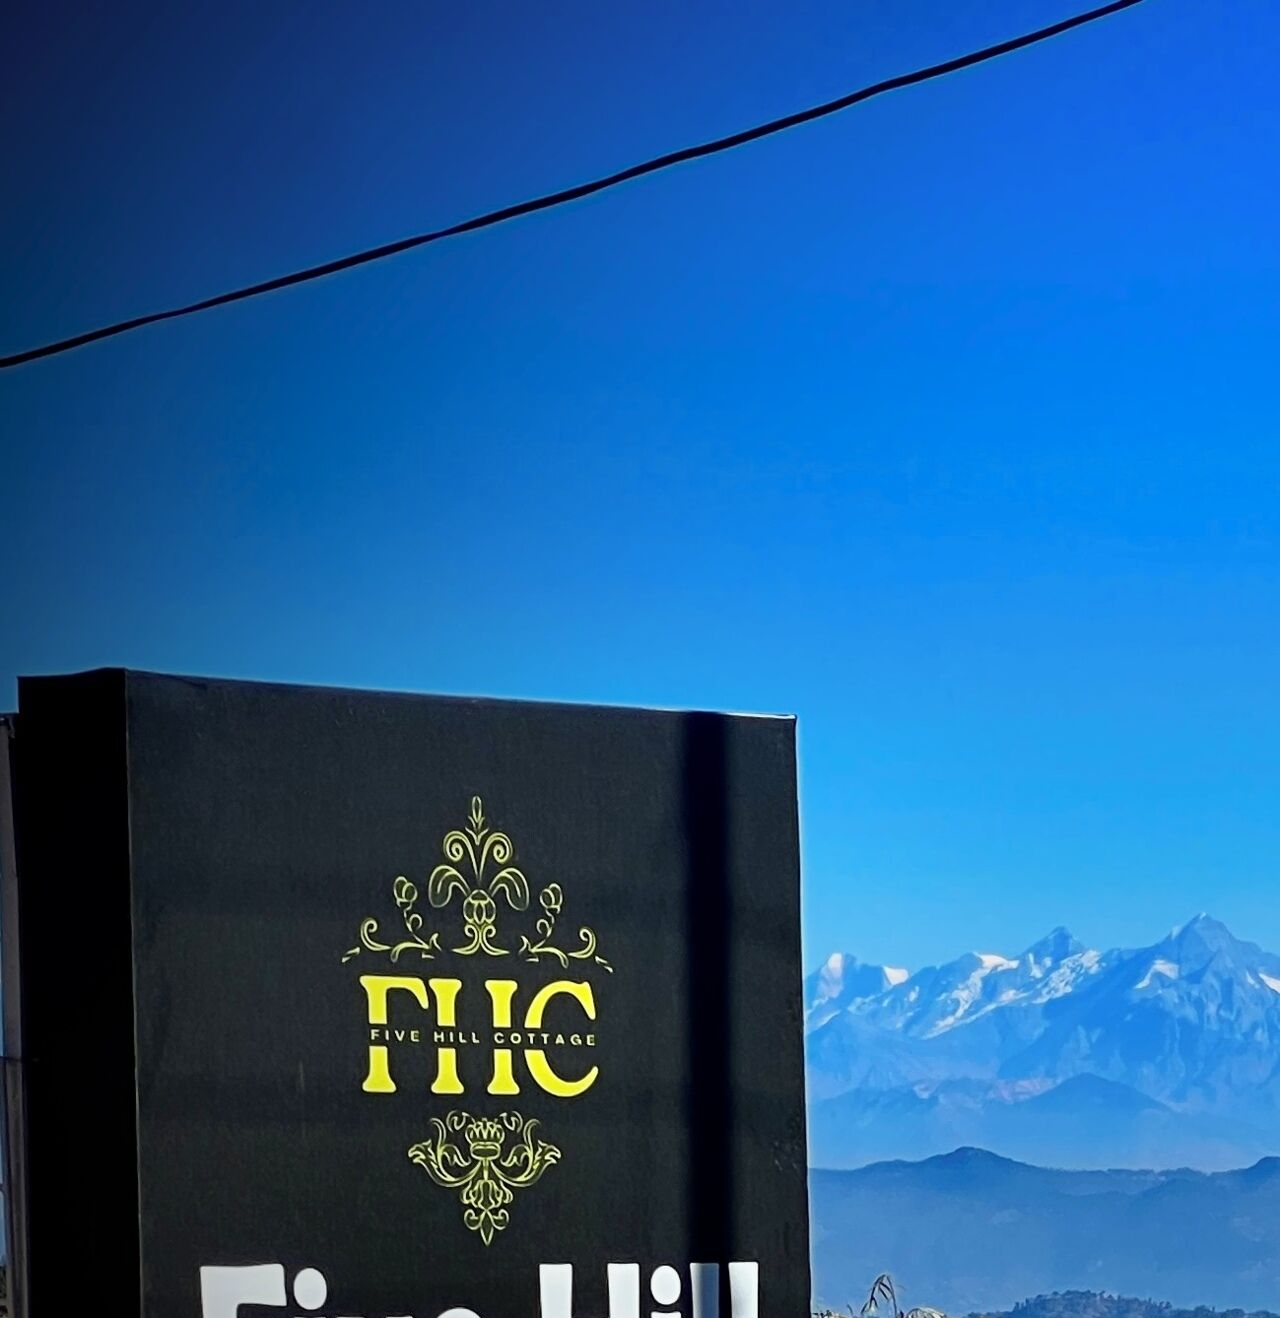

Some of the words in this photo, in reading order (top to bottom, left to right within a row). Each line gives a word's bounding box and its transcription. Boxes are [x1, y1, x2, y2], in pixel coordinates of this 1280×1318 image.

[370, 1028, 420, 1043] FIVE
[433, 1031, 480, 1044] HILL
[494, 1032, 596, 1046] COTTAGE
